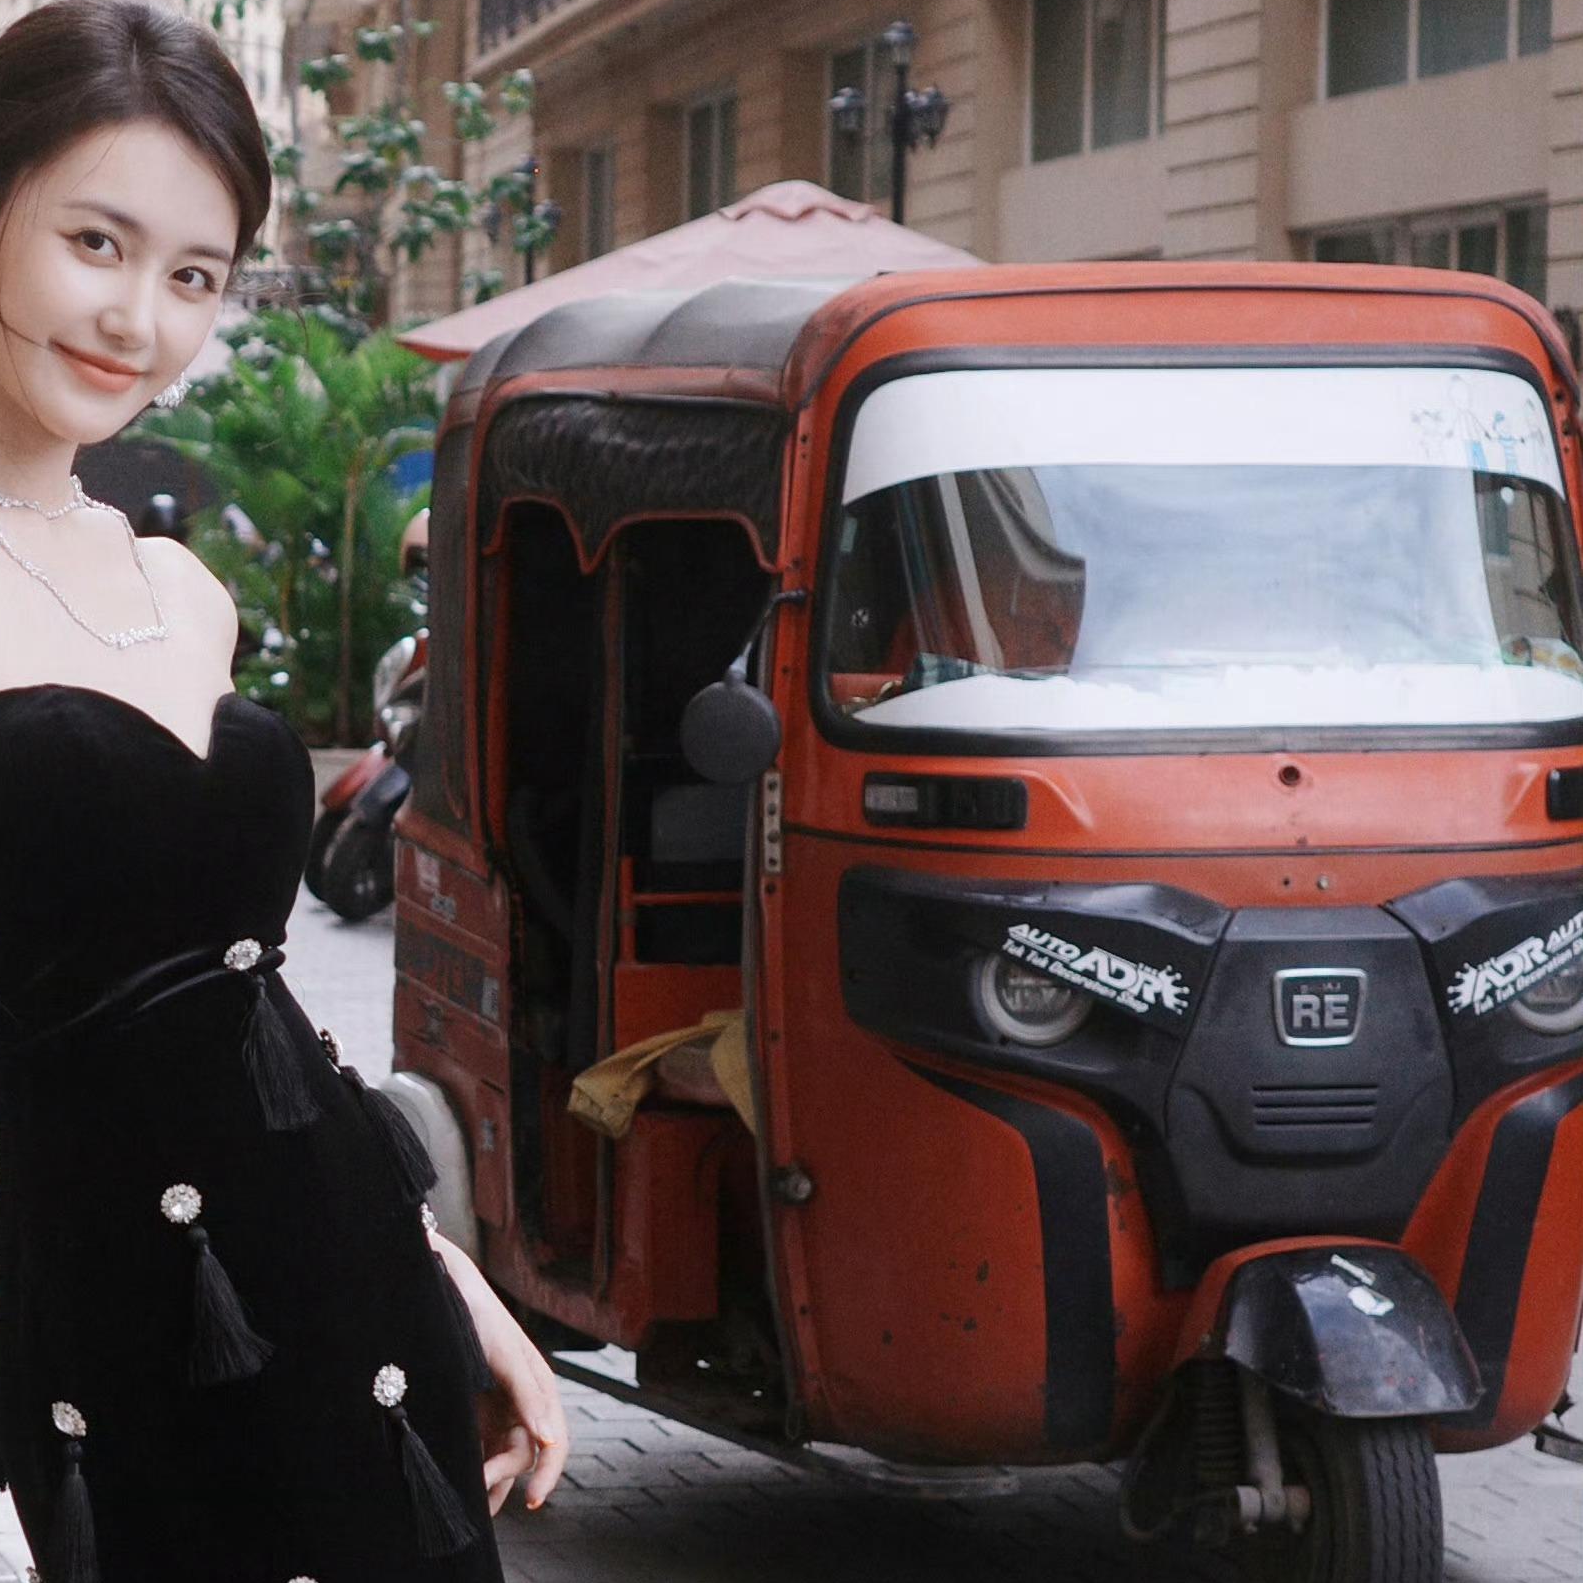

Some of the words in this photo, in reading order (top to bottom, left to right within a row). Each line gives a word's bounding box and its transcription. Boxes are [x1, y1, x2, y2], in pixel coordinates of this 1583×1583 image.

[1008, 923, 1081, 962] AUTO
[1069, 946, 1163, 1004] ADR
[1474, 936, 1549, 1003] ADR
[1292, 994, 1350, 1028] RE
